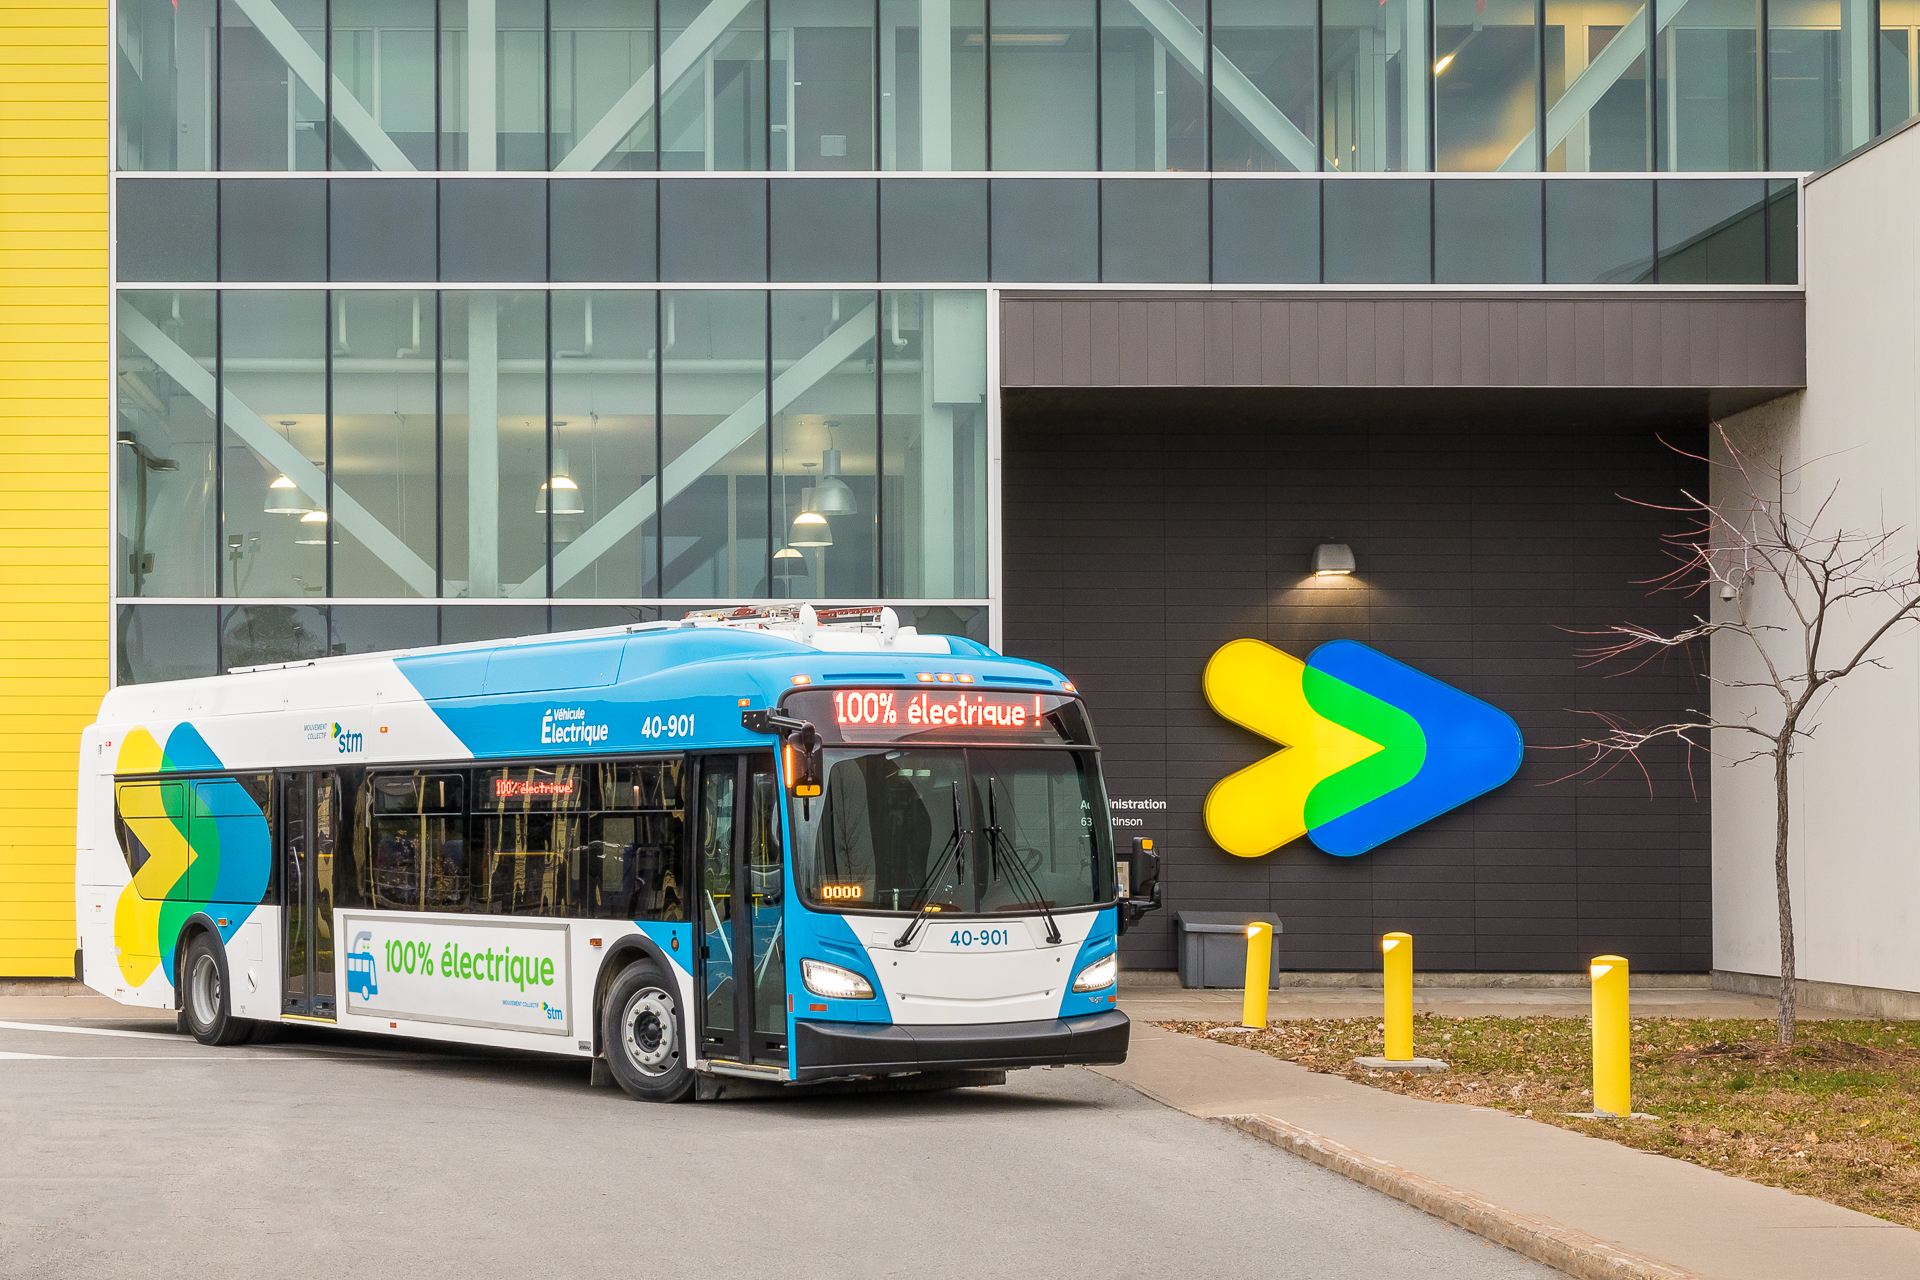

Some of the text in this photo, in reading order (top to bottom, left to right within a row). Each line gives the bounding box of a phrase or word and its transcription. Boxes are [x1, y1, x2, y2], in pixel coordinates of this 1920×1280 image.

[553, 707, 585, 721] Véhicule
[835, 691, 1042, 727] 100% électrique !
[303, 723, 328, 731] MOUVEMENT
[541, 709, 608, 746] Électrique
[641, 713, 695, 739] 40-901
[307, 732, 327, 740] COLLECTIF
[338, 729, 363, 754] stm
[496, 779, 518, 796] 100%
[1080, 798, 1167, 810] Ainistration
[823, 886, 861, 899] 0000
[950, 929, 1008, 946] 40-901
[385, 939, 555, 993] 100% électrique
[546, 1007, 563, 1020] stm
